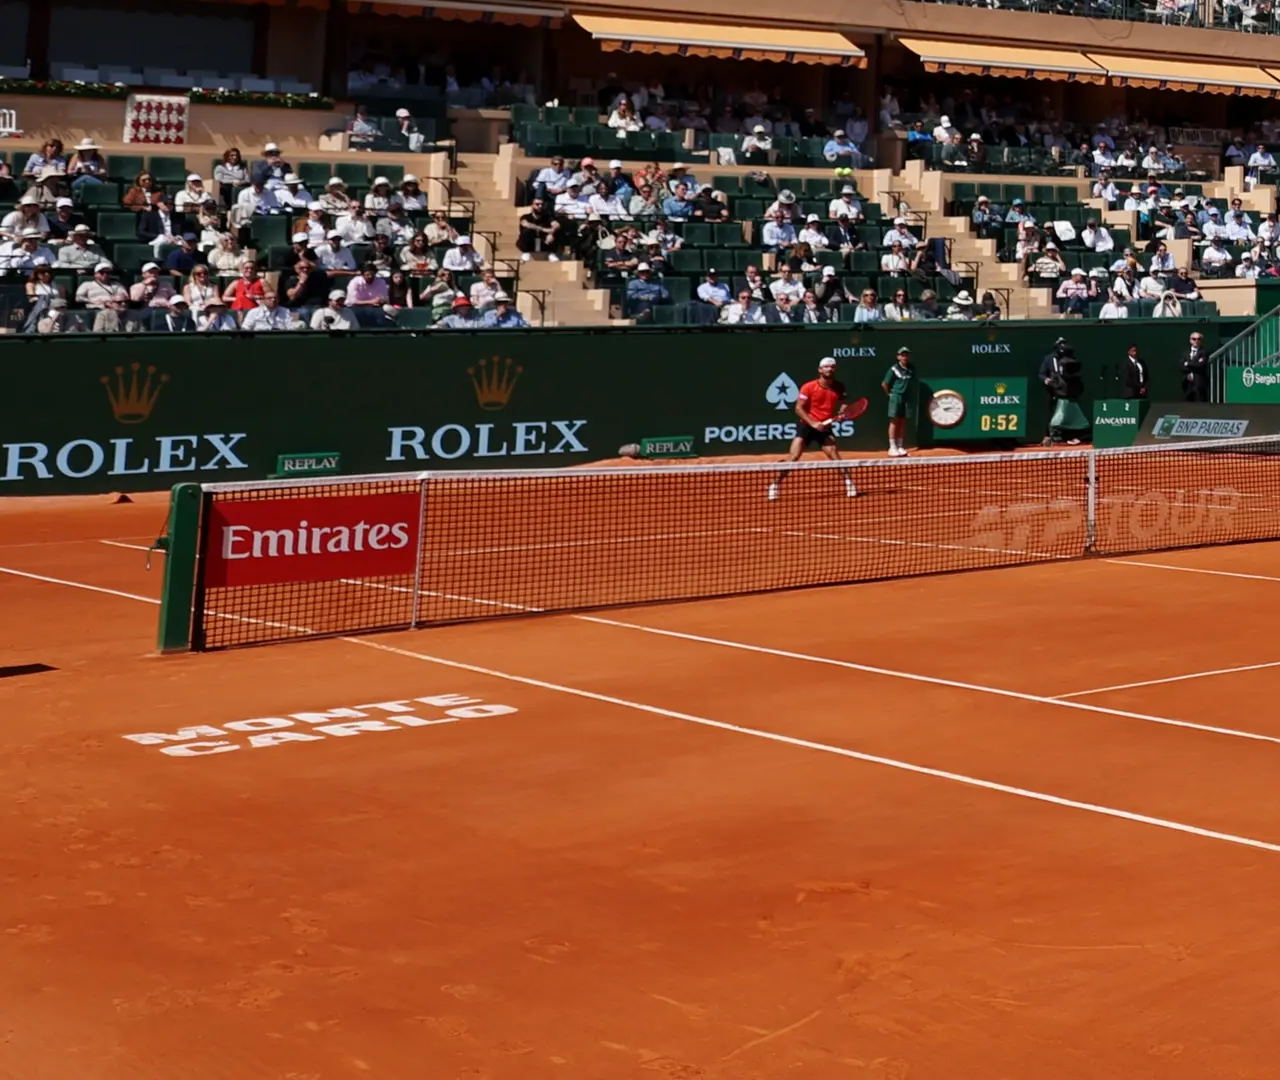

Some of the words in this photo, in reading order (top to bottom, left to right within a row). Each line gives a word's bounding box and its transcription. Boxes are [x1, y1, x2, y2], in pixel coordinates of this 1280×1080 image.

[833, 347, 876, 357] ROLEX
[971, 343, 1011, 354] ROLEX
[1255, 375, 1276, 386] Sergio
[980, 395, 1021, 405] ROLEX
[1102, 403, 1108, 412] 1
[1124, 403, 1130, 412] 2
[980, 414, 1018, 431] 0:52
[1095, 416, 1137, 426] LANCASTER
[1175, 420, 1200, 435] BNP
[1199, 421, 1243, 436] PARIBAS
[704, 420, 855, 444] POKERSRS
[386, 420, 589, 462] ROLEX
[646, 439, 694, 455] REPLAY
[0, 433, 249, 481] ROLEX
[283, 456, 340, 472] REPLAY
[1100, 486, 1243, 541] TOUR
[222, 520, 409, 560] Emirates
[121, 692, 484, 746] MONTE
[159, 704, 520, 758] CARLO
